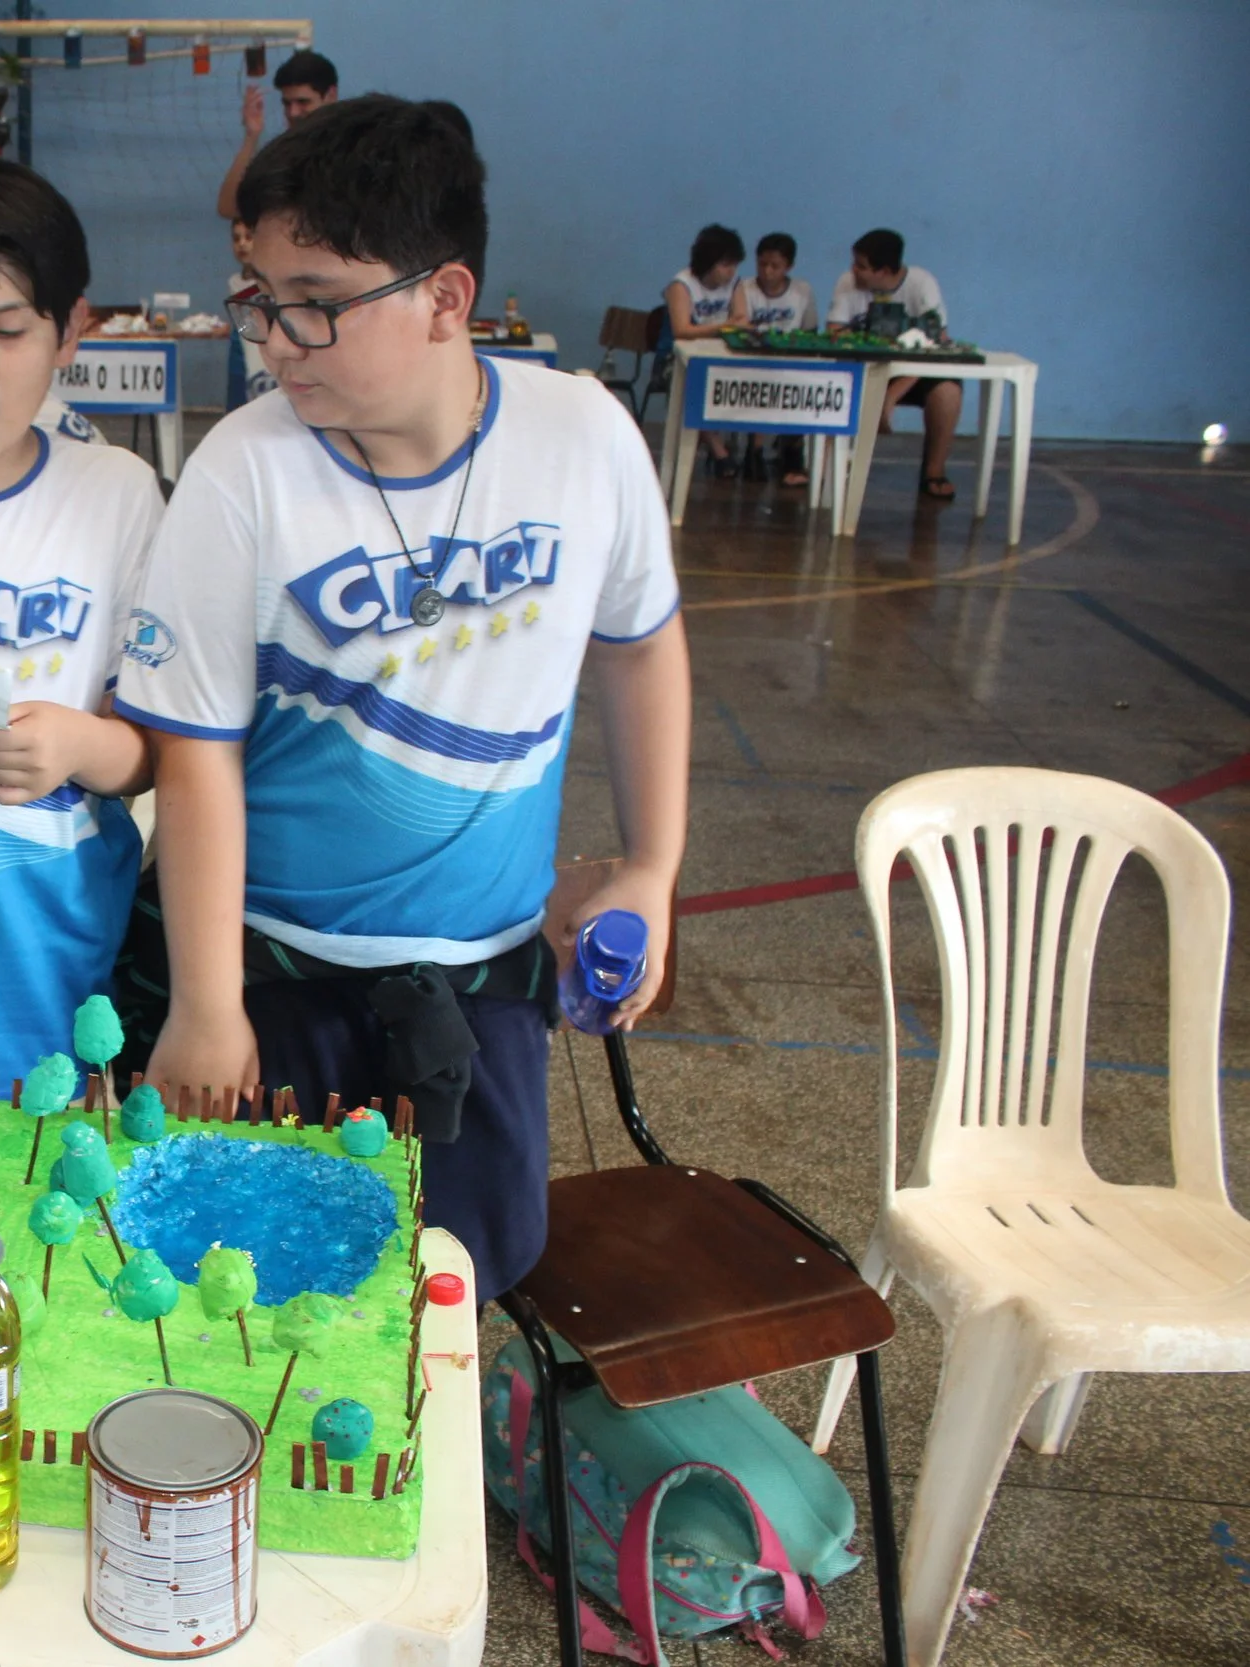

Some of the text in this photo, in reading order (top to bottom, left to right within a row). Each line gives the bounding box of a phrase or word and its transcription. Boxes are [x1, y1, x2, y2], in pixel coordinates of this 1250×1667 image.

[97, 364, 107, 391] O
[121, 364, 164, 391] LIXO
[713, 380, 844, 417] BIORREMEDIAÇÃO
